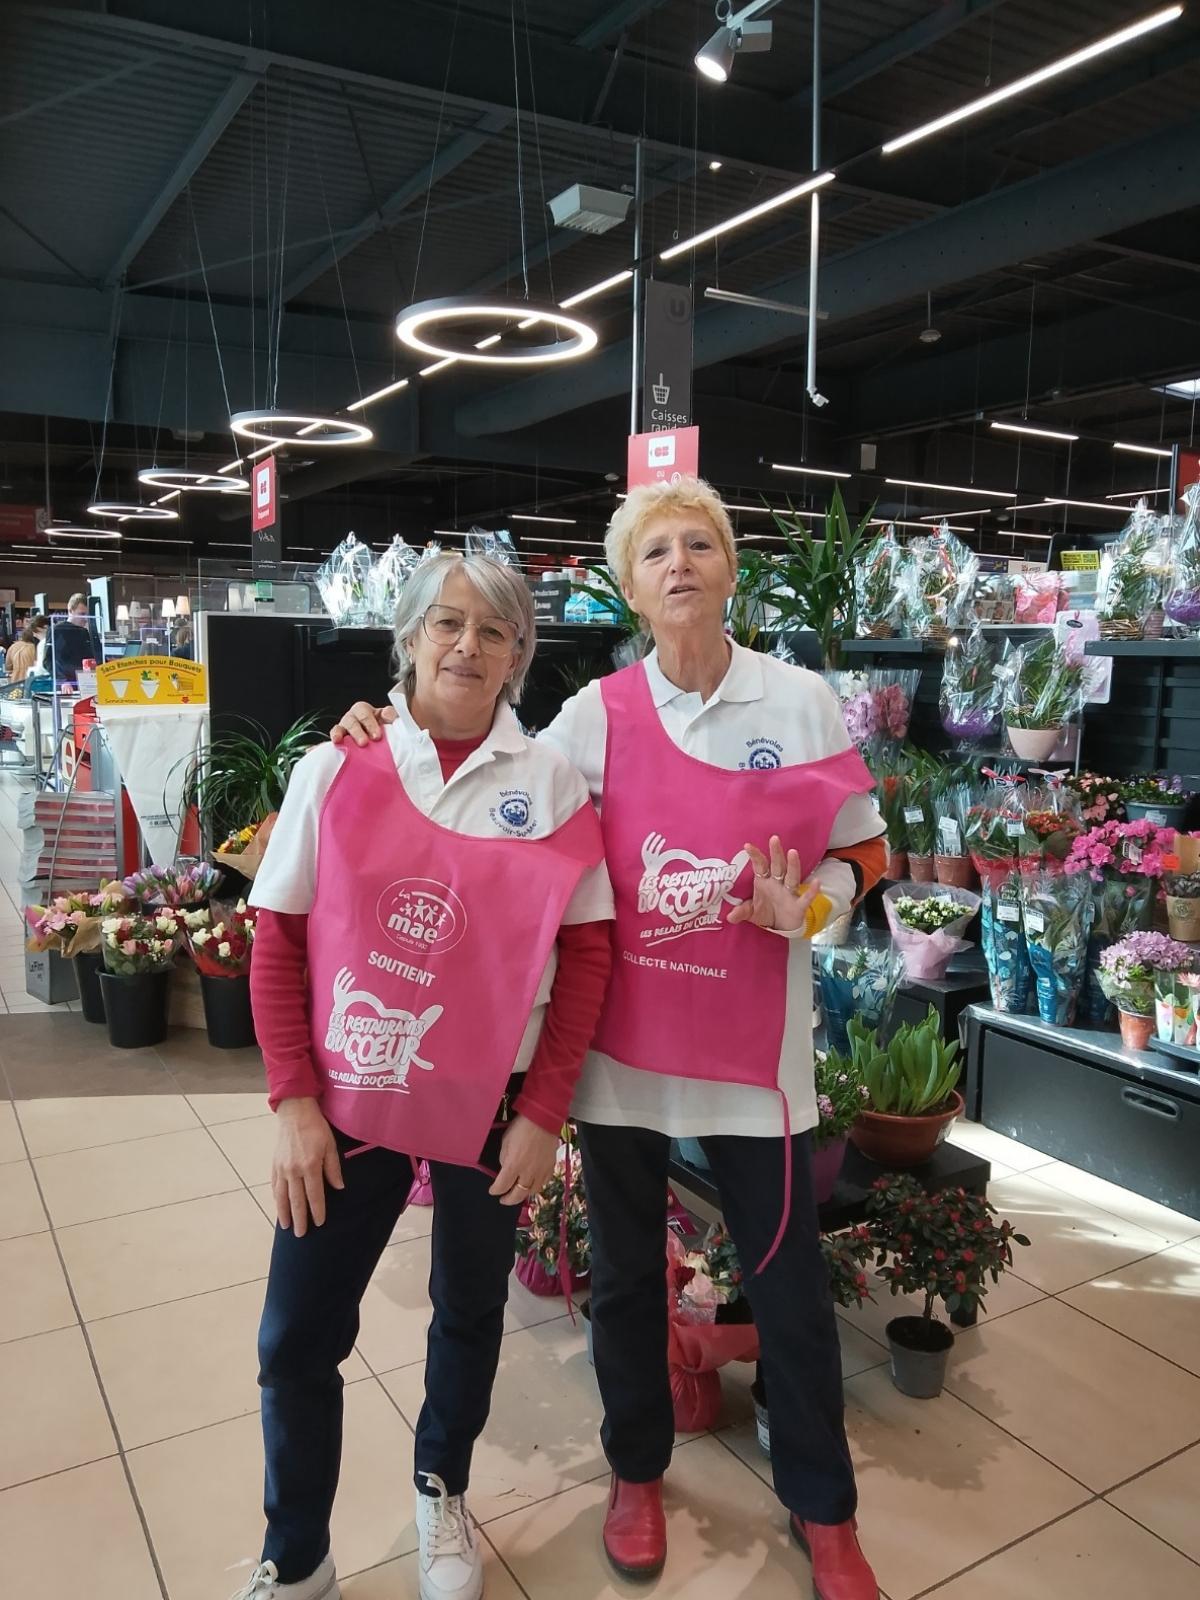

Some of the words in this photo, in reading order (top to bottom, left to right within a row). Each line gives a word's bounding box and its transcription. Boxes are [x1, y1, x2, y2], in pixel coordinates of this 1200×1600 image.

[651, 409, 687, 424] Caisses
[639, 876, 659, 891] LES
[659, 864, 738, 889] RESTAURANTS
[387, 913, 438, 944] mae
[367, 950, 437, 988] SOUTIENT
[623, 950, 668, 970] COLLECTE
[669, 961, 728, 979] NATIONALE
[345, 1014, 426, 1037] RESTAURANTS
[362, 1075, 377, 1086] DU
